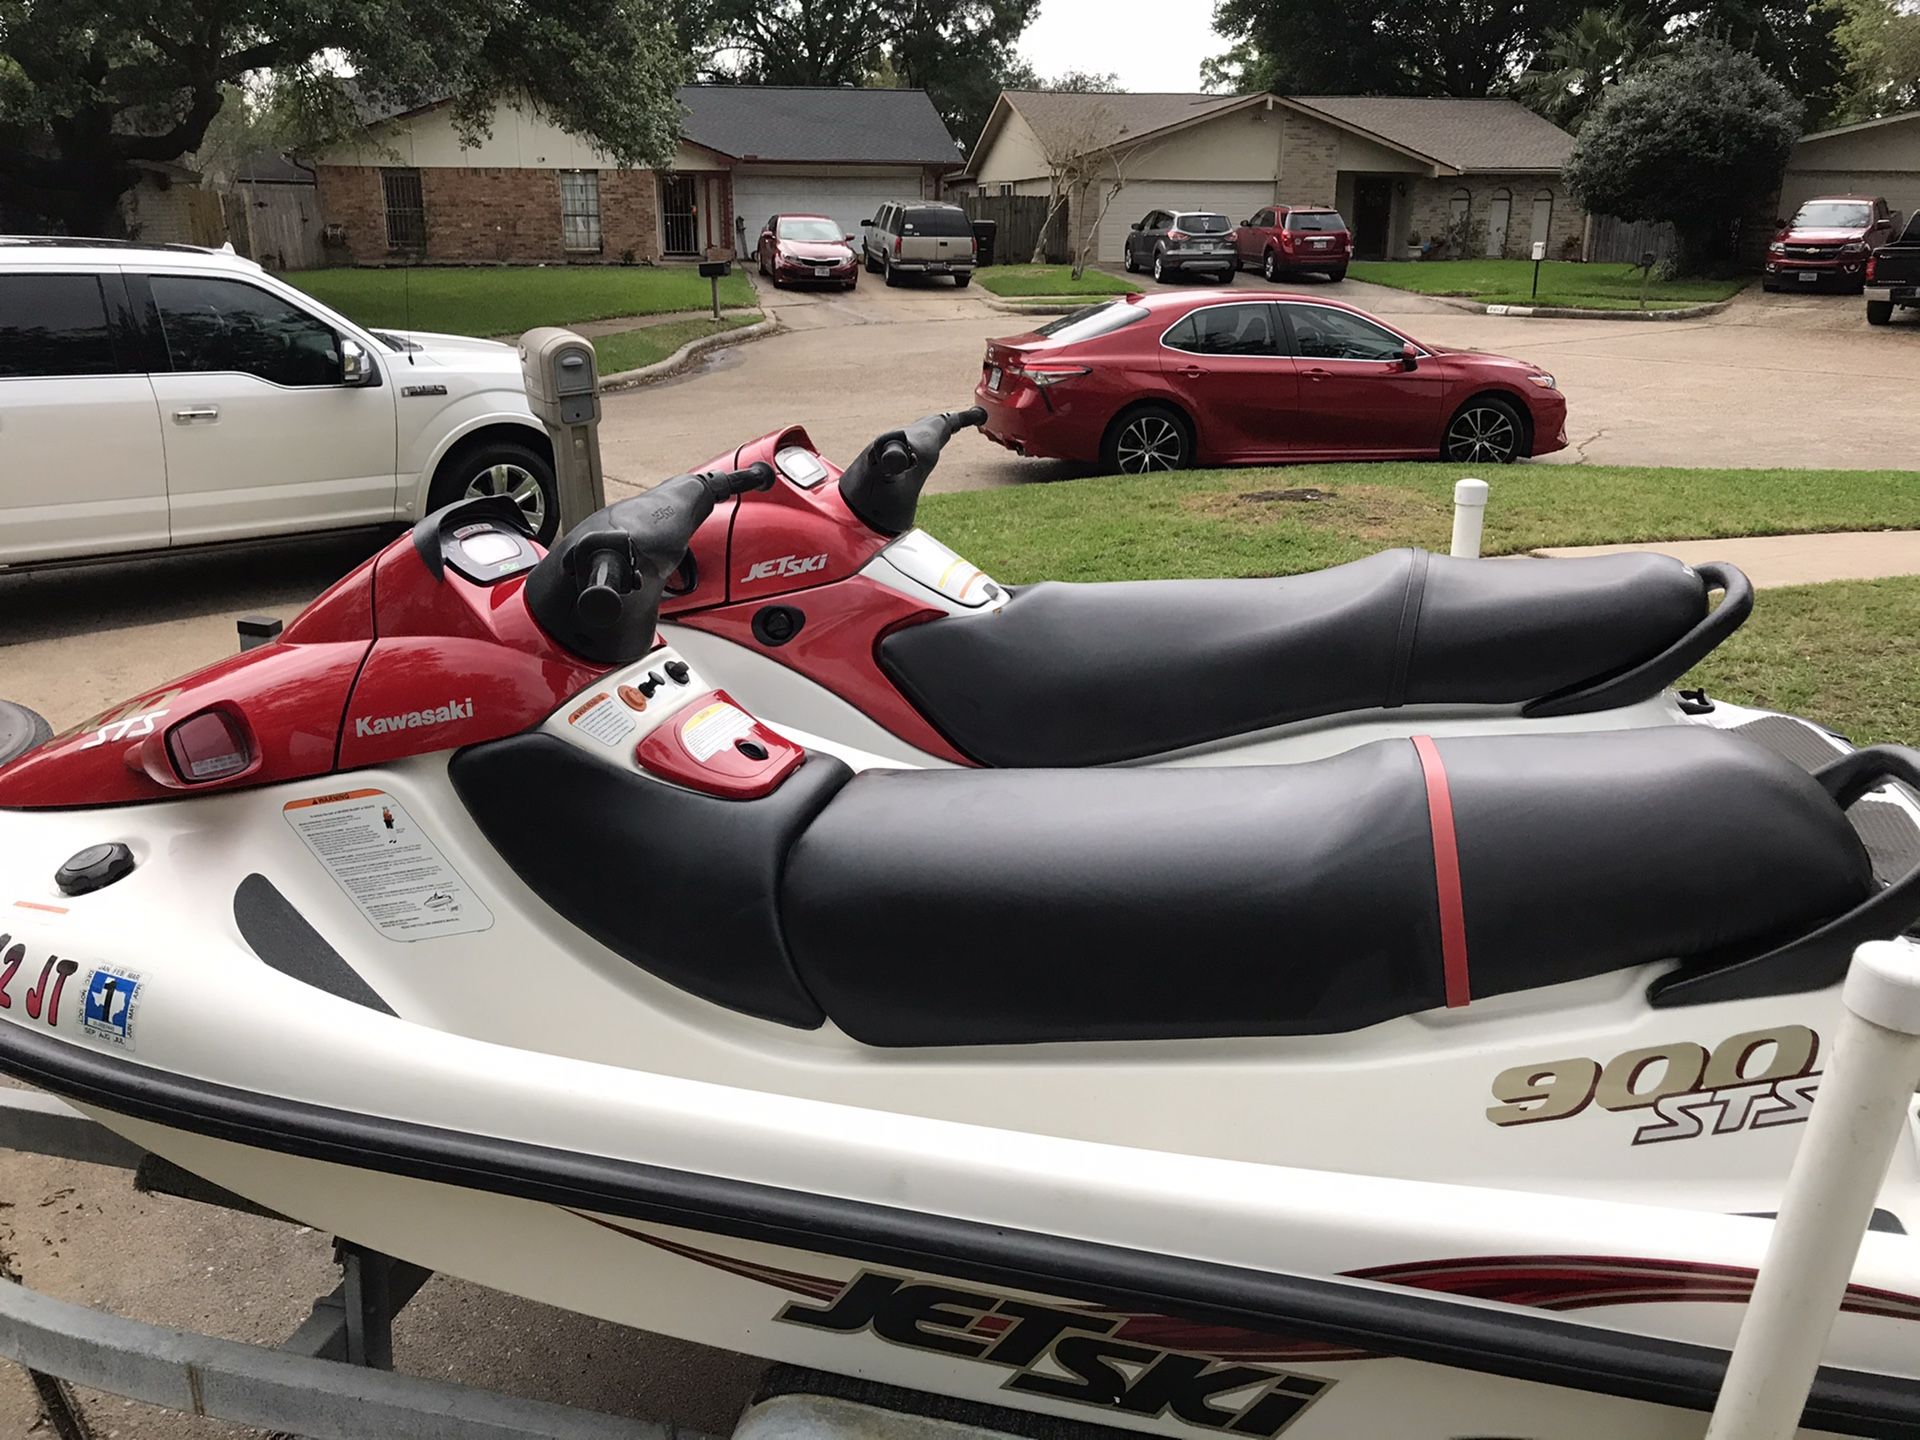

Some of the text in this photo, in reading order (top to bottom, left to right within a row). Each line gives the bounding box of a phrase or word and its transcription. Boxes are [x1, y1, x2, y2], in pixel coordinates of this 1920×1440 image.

[80, 709, 170, 750] STS
[355, 697, 474, 738] Kawasaki
[318, 793, 350, 804] WARNING
[104, 980, 117, 1023] 1
[1486, 1024, 1820, 1127] 900
[1631, 1070, 1824, 1146] STS
